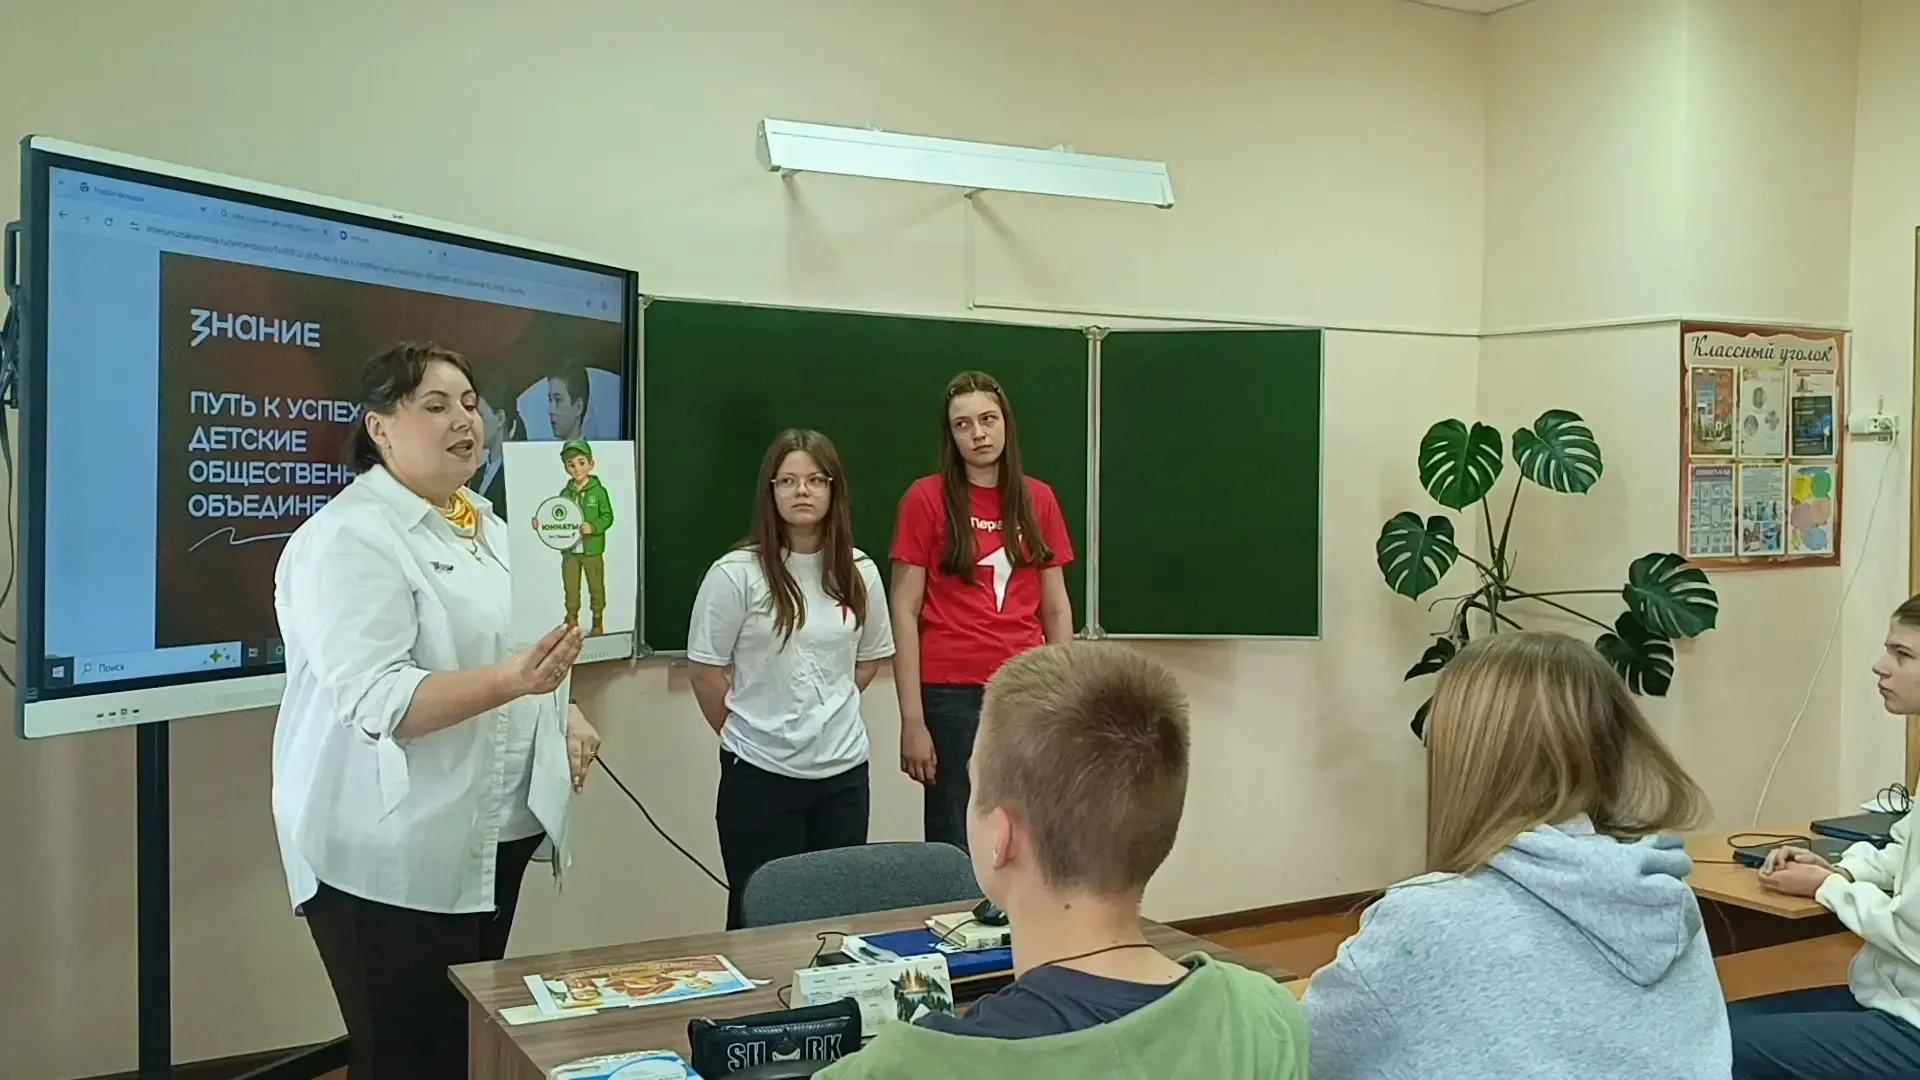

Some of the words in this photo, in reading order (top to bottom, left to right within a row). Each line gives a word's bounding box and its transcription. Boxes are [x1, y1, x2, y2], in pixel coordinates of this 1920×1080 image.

[190, 308, 321, 348] ЗНАНИЕ
[1691, 334, 1776, 359] Классный
[1779, 345, 1833, 366] уголок
[190, 391, 257, 418] ПУТЬ
[264, 396, 281, 418] К
[287, 398, 362, 423] УСПЕХ
[188, 426, 307, 452] ДЕТСКИЕ
[188, 460, 356, 486] ОБЩЕСТВЕНН
[188, 494, 333, 519] ОБЪЕДИНЕ
[541, 523, 579, 531] ЮННАТЫ
[98, 663, 125, 673] Поиск
